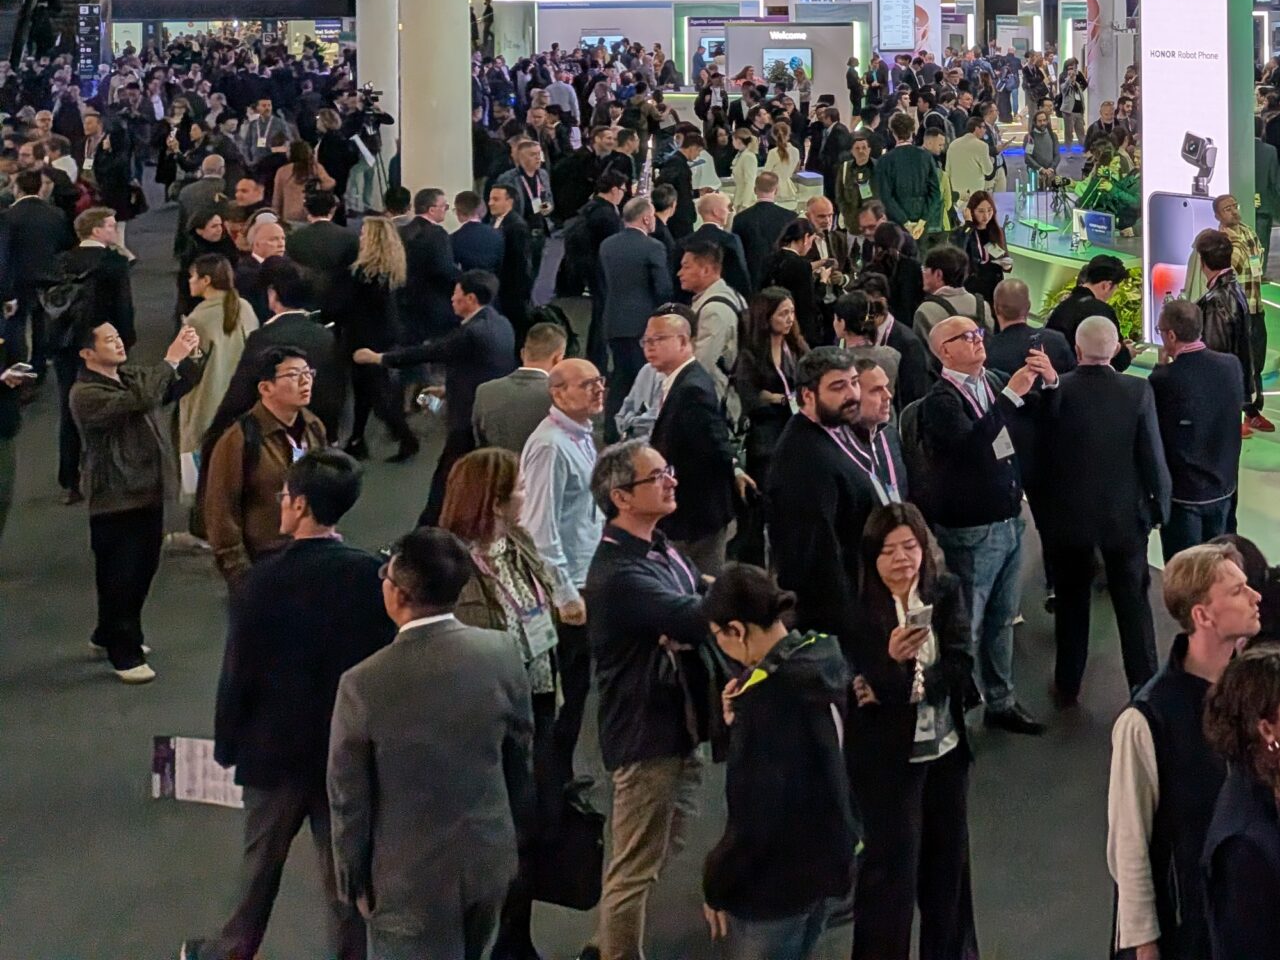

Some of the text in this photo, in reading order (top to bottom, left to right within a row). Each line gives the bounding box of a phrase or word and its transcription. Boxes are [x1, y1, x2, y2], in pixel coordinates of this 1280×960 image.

[769, 31, 808, 41] Welcome
[1150, 49, 1219, 60] HONOR Robot Phone
